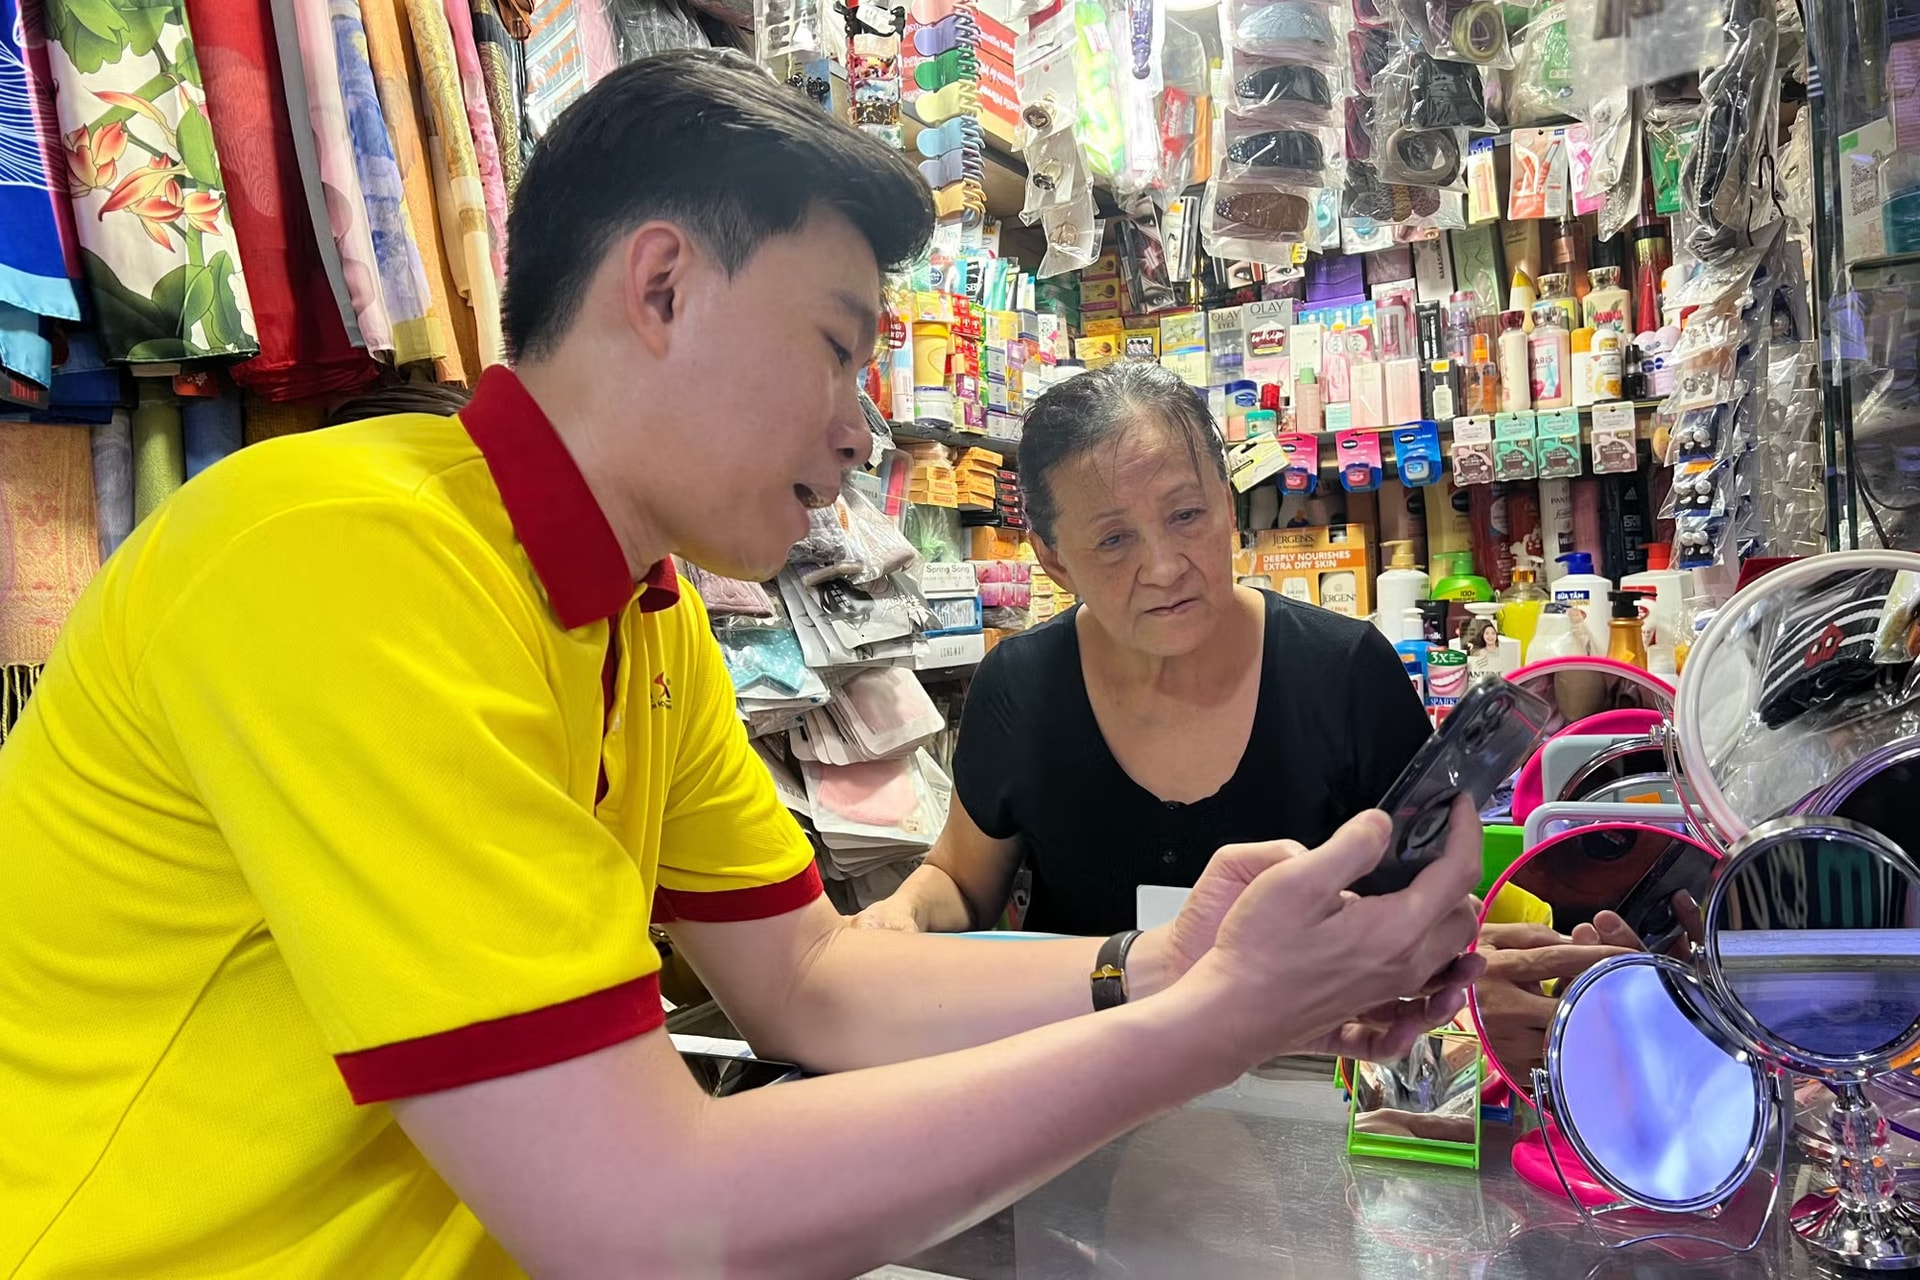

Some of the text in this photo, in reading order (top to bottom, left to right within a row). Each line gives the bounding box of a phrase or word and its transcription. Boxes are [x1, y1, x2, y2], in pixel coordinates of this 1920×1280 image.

[1250, 301, 1285, 314] OLAY
[1211, 310, 1240, 322] OLAY
[1251, 328, 1286, 342] whip
[1535, 356, 1553, 364] ARIS
[1274, 534, 1314, 545] JERGENS
[1264, 551, 1350, 562] DEEPLY NOURISHES
[926, 565, 970, 574] Spring Song
[1263, 560, 1337, 571] EXTRA DRY SKIN
[1431, 652, 1448, 663] 3X
[1468, 671, 1503, 679] ANTENE
